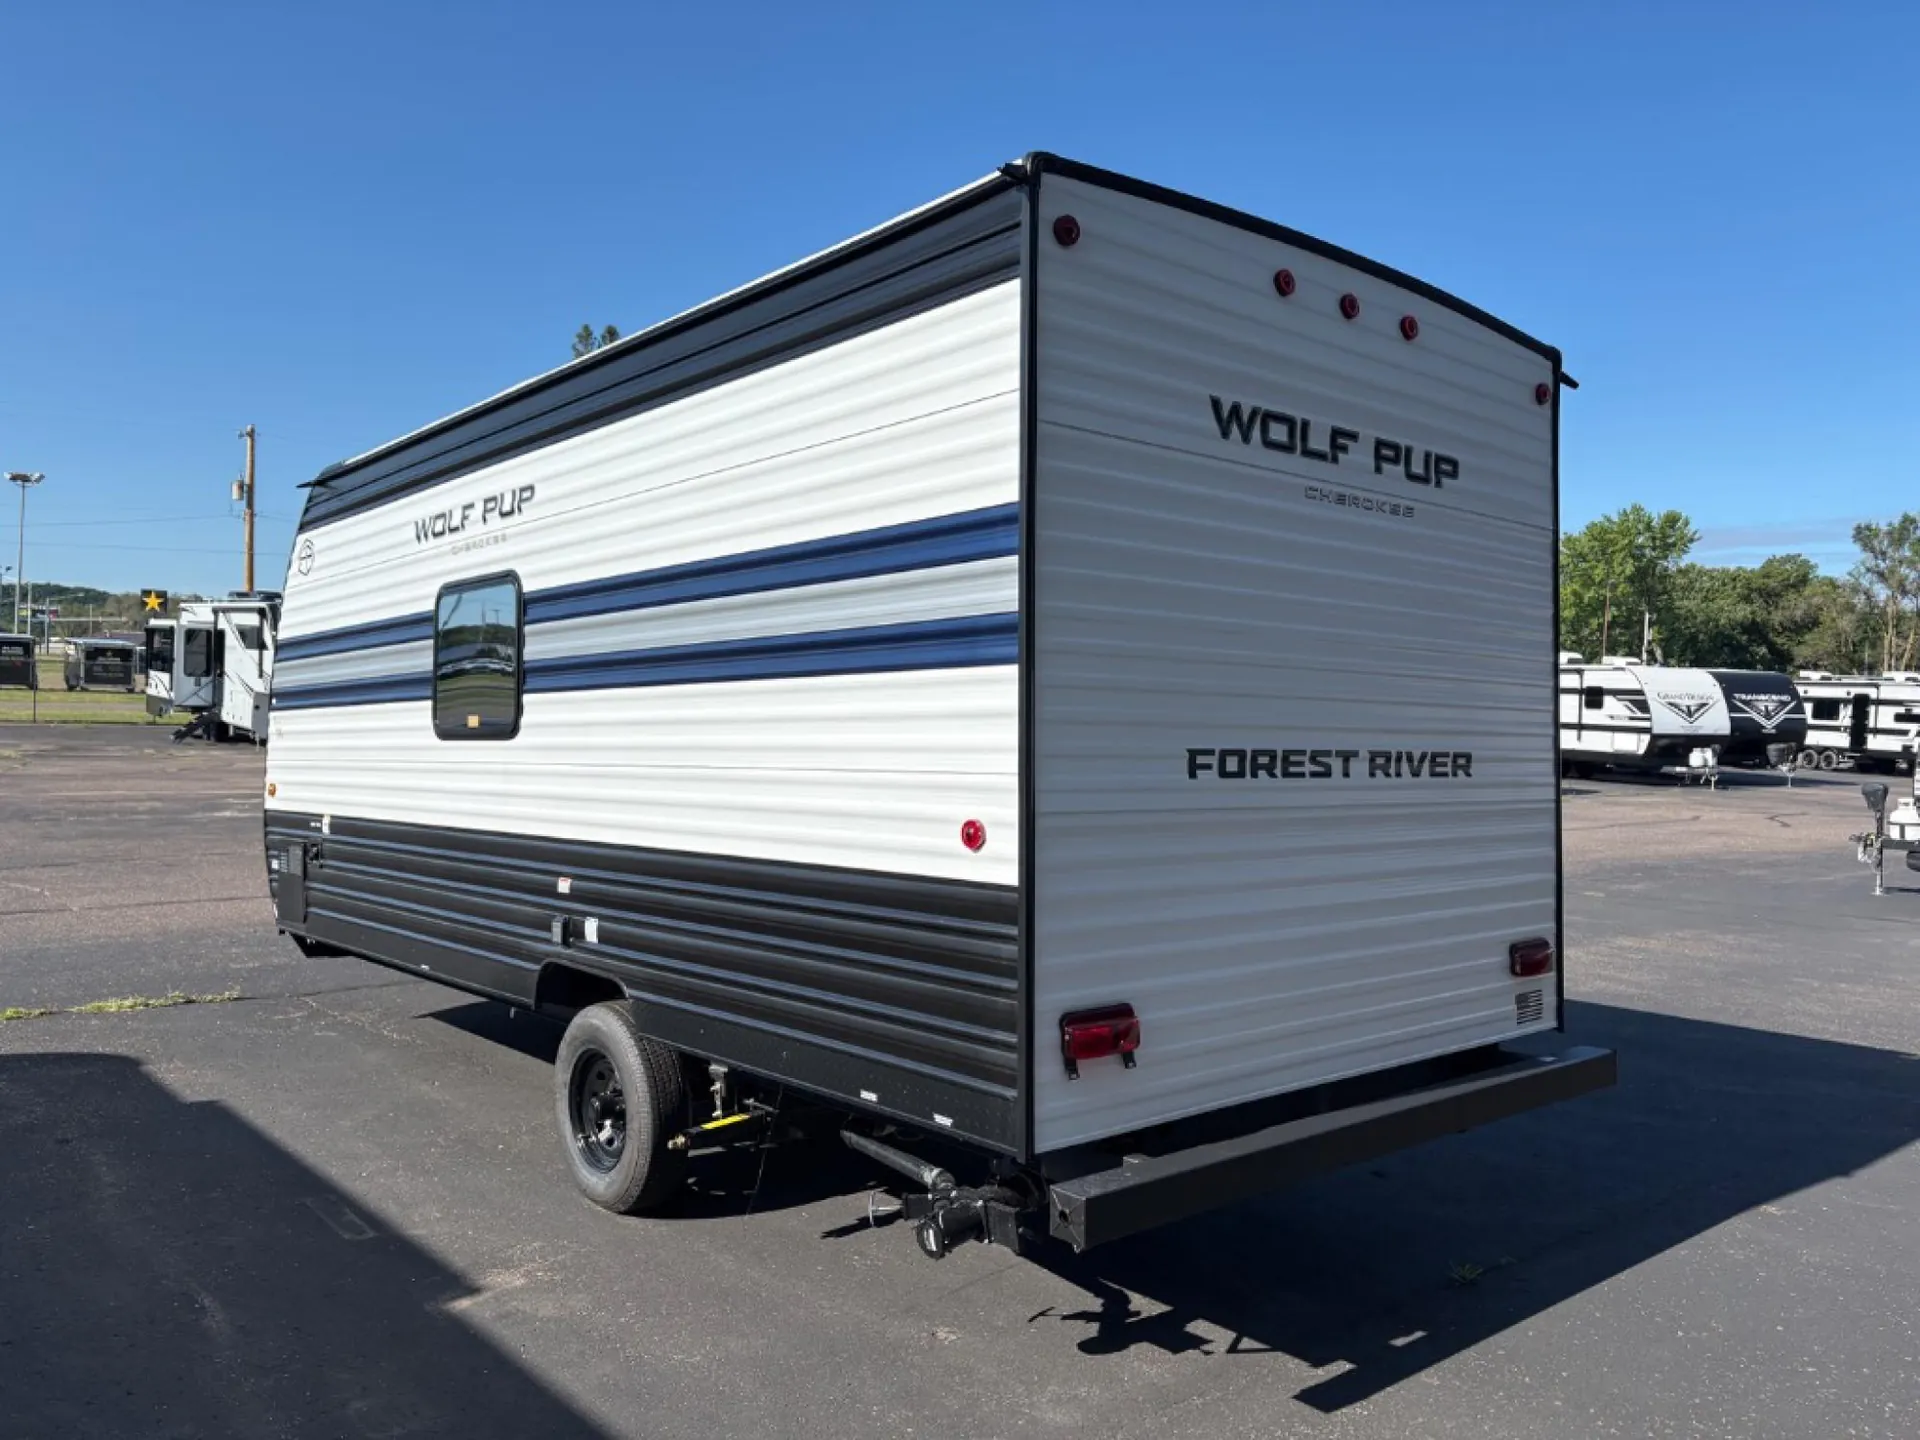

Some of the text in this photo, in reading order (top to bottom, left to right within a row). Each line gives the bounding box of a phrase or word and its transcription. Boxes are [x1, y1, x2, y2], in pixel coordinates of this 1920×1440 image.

[1208, 393, 1459, 488] WOLF PUP
[414, 483, 535, 545] WOLF PUP
[1304, 485, 1415, 518] CHEROKEE
[1186, 748, 1473, 780] FOREST RIVER
